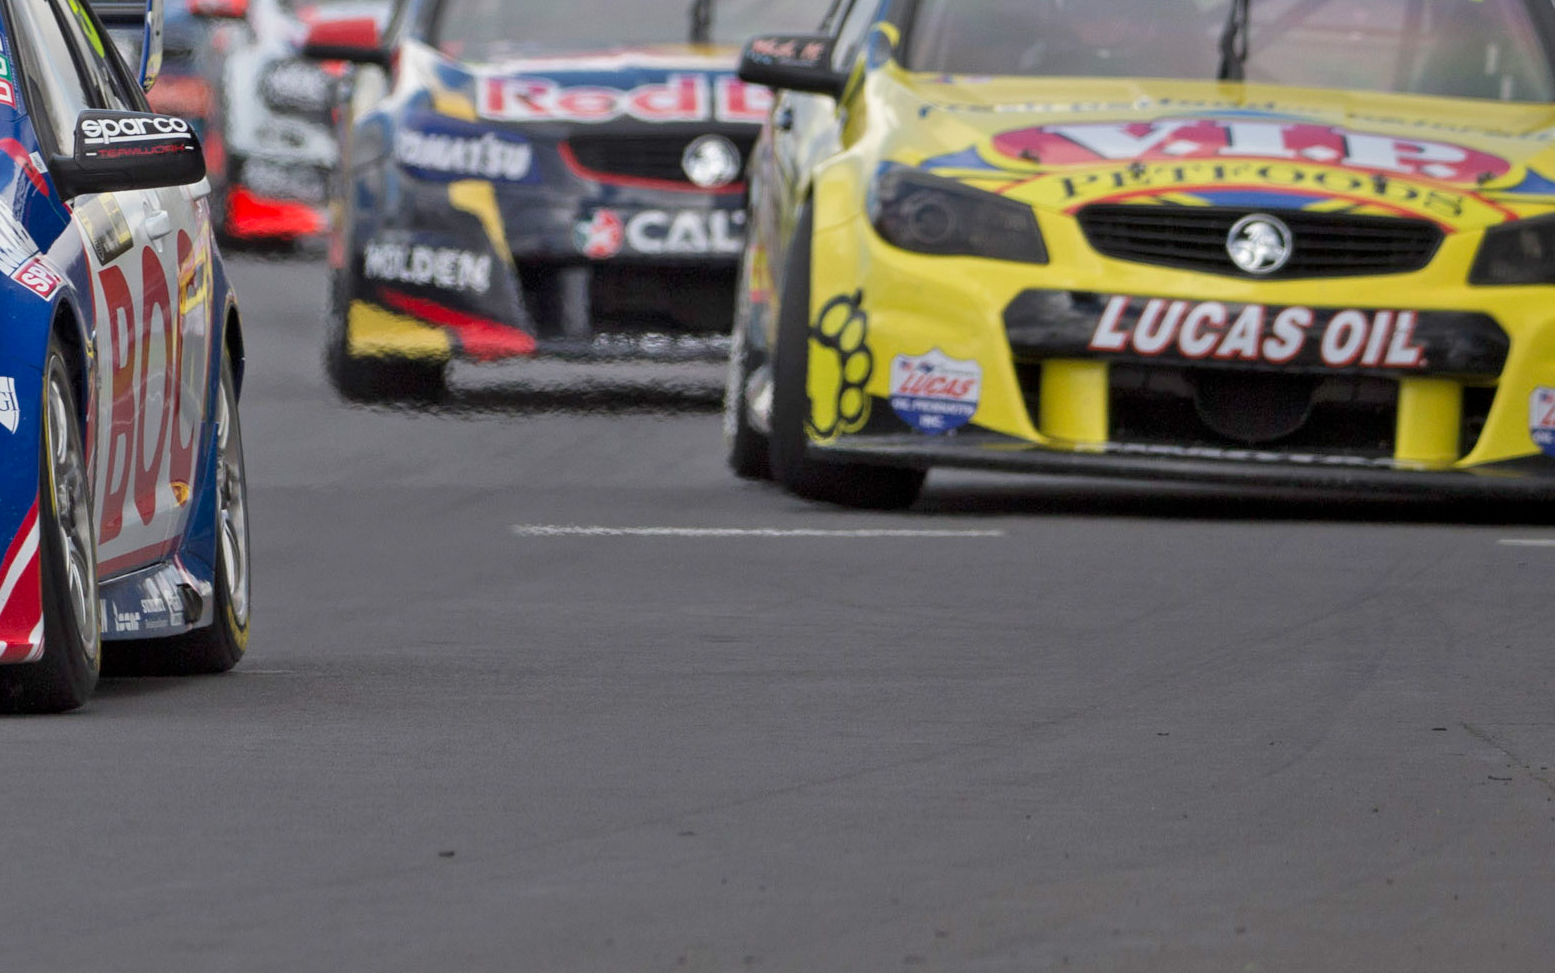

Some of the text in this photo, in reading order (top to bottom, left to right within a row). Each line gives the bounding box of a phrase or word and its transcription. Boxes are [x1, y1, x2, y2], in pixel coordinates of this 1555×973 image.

[478, 73, 708, 123] Red
[81, 116, 188, 144] sparco
[1060, 164, 1464, 219] PETFOODS
[1088, 294, 1426, 369] LUCAS OIL
[898, 372, 977, 399] LUCAS
